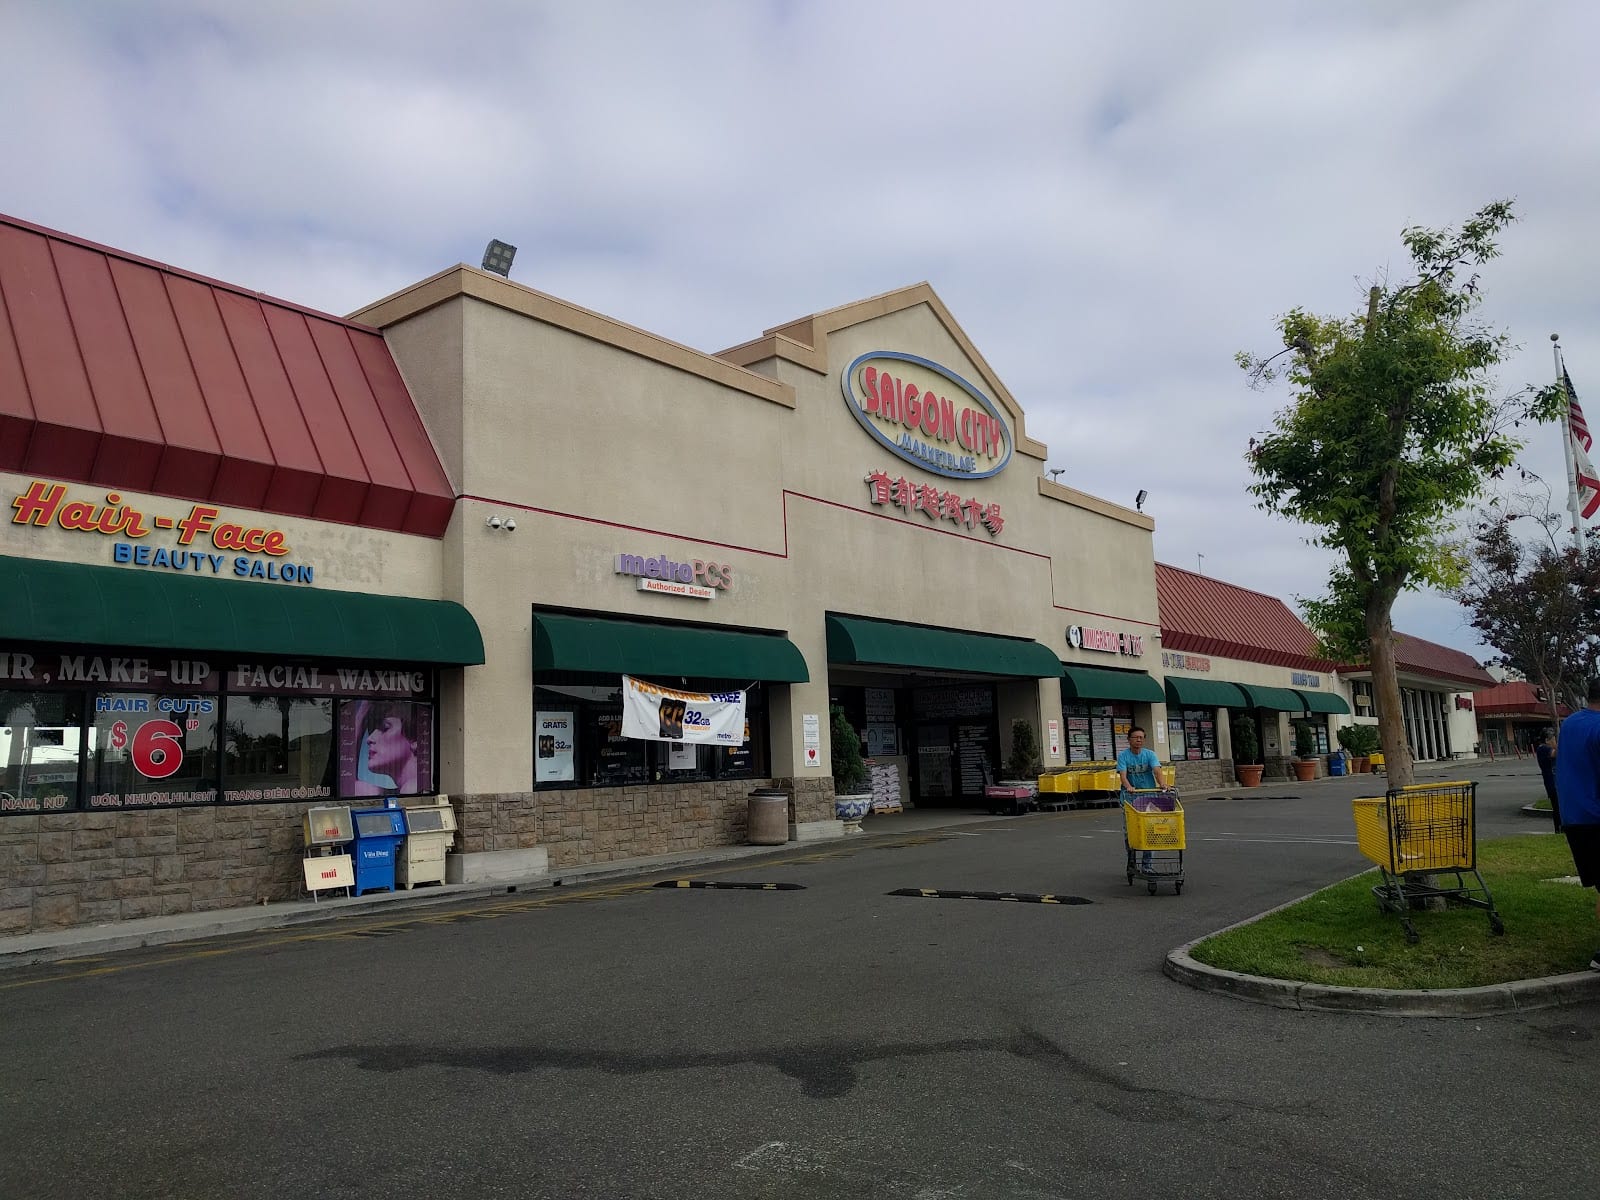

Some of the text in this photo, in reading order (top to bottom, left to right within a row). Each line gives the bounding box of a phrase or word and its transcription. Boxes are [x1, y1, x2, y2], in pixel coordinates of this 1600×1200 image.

[860, 366, 1001, 459] SAIGON CITY
[898, 432, 977, 473] MARKETPLACE
[865, 470, 1005, 537] 首都超級市場
[114, 542, 314, 584] BEAUTY SALON
[616, 553, 733, 590] metroPCS
[646, 581, 712, 597] Authorized Dealer
[96, 697, 214, 713] HAIR CUTS
[710, 691, 741, 704] FREE
[186, 719, 199, 731] UP
[542, 721, 568, 729] GRATIS
[224, 790, 263, 802] TRANG
